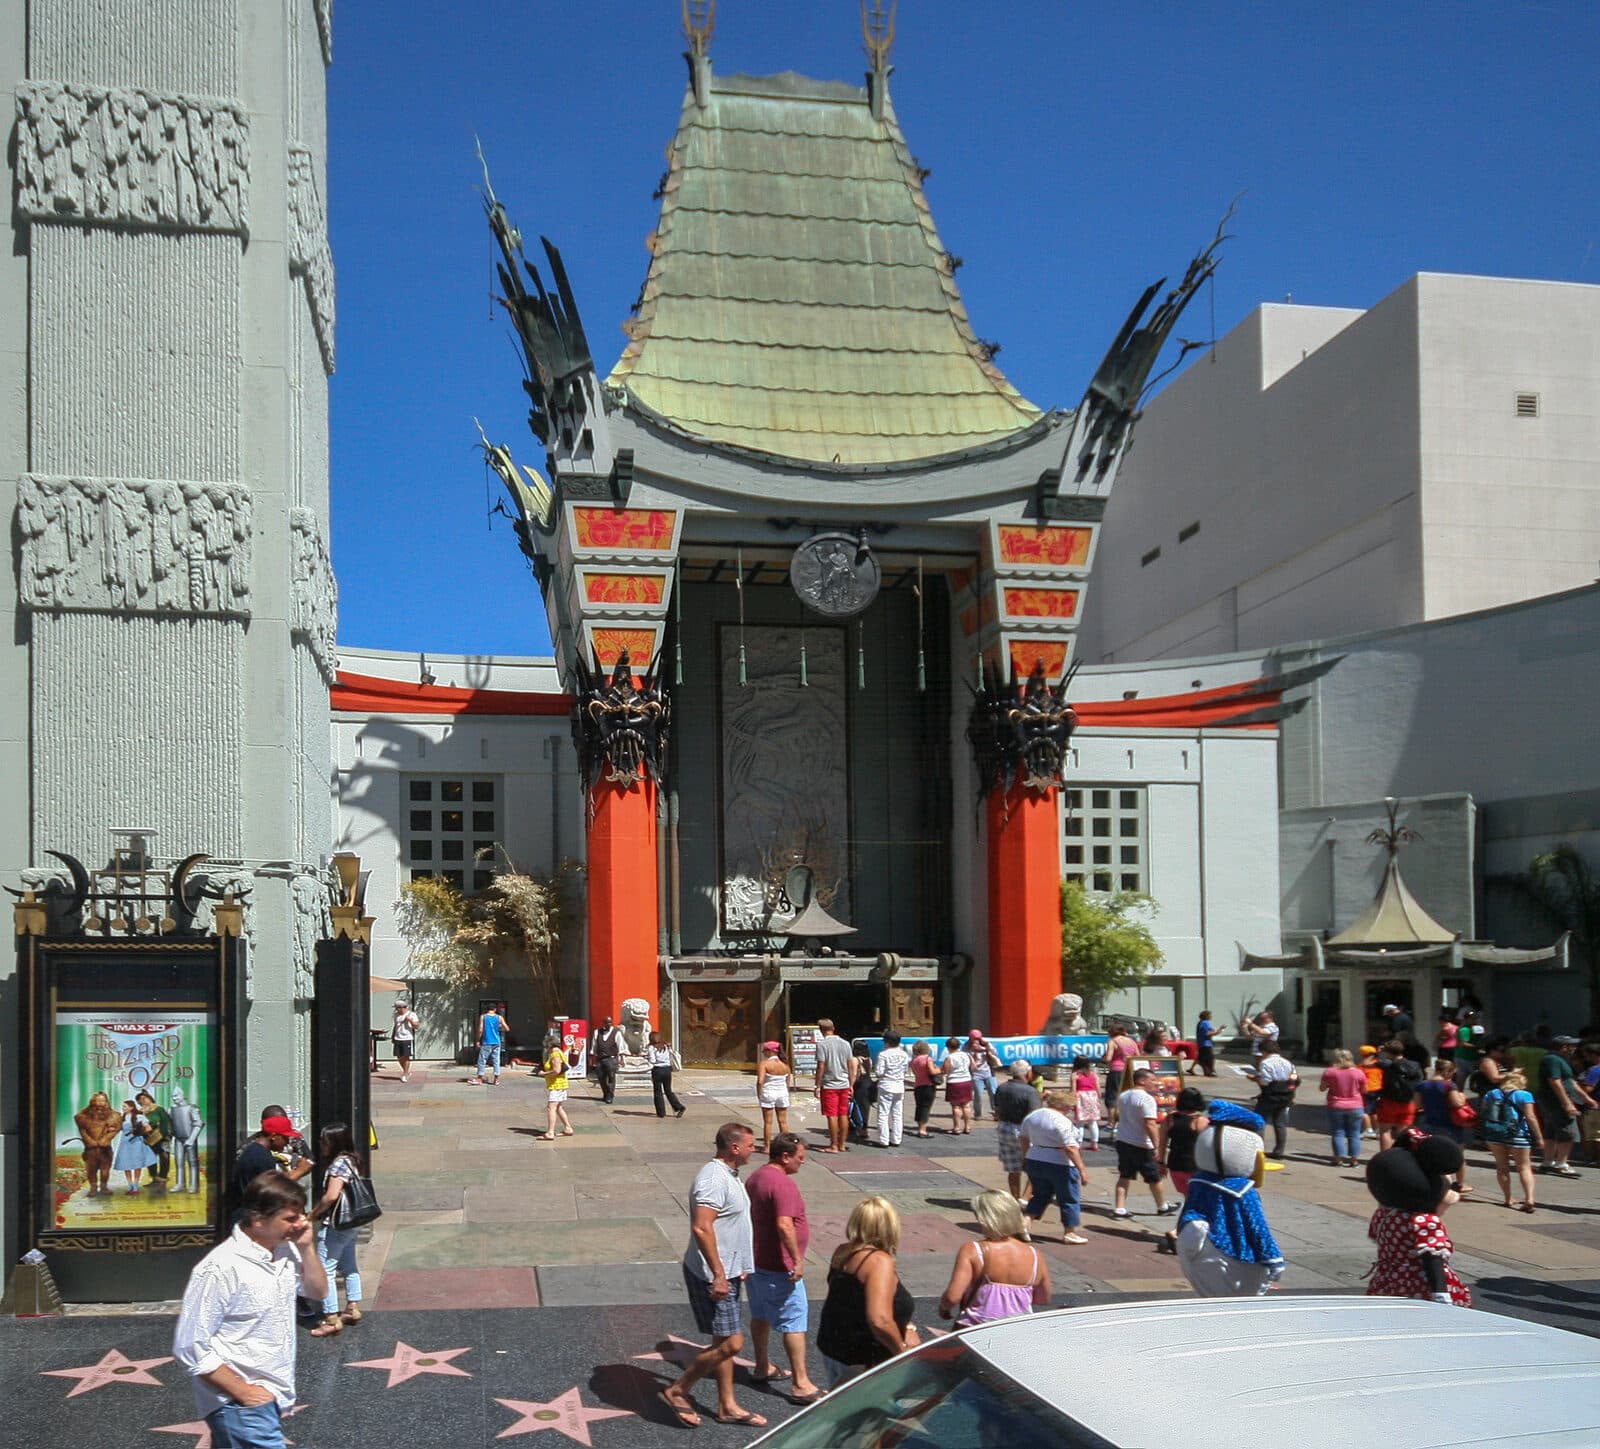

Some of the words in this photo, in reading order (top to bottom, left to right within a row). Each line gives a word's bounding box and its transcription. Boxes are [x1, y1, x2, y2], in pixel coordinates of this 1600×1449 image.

[86, 1034, 181, 1070] WIZARD
[88, 1033, 117, 1050] The
[1004, 1043, 1069, 1059] COMING
[114, 1071, 127, 1082] of
[128, 1062, 170, 1089] OZ
[175, 1066, 194, 1079] 3D
